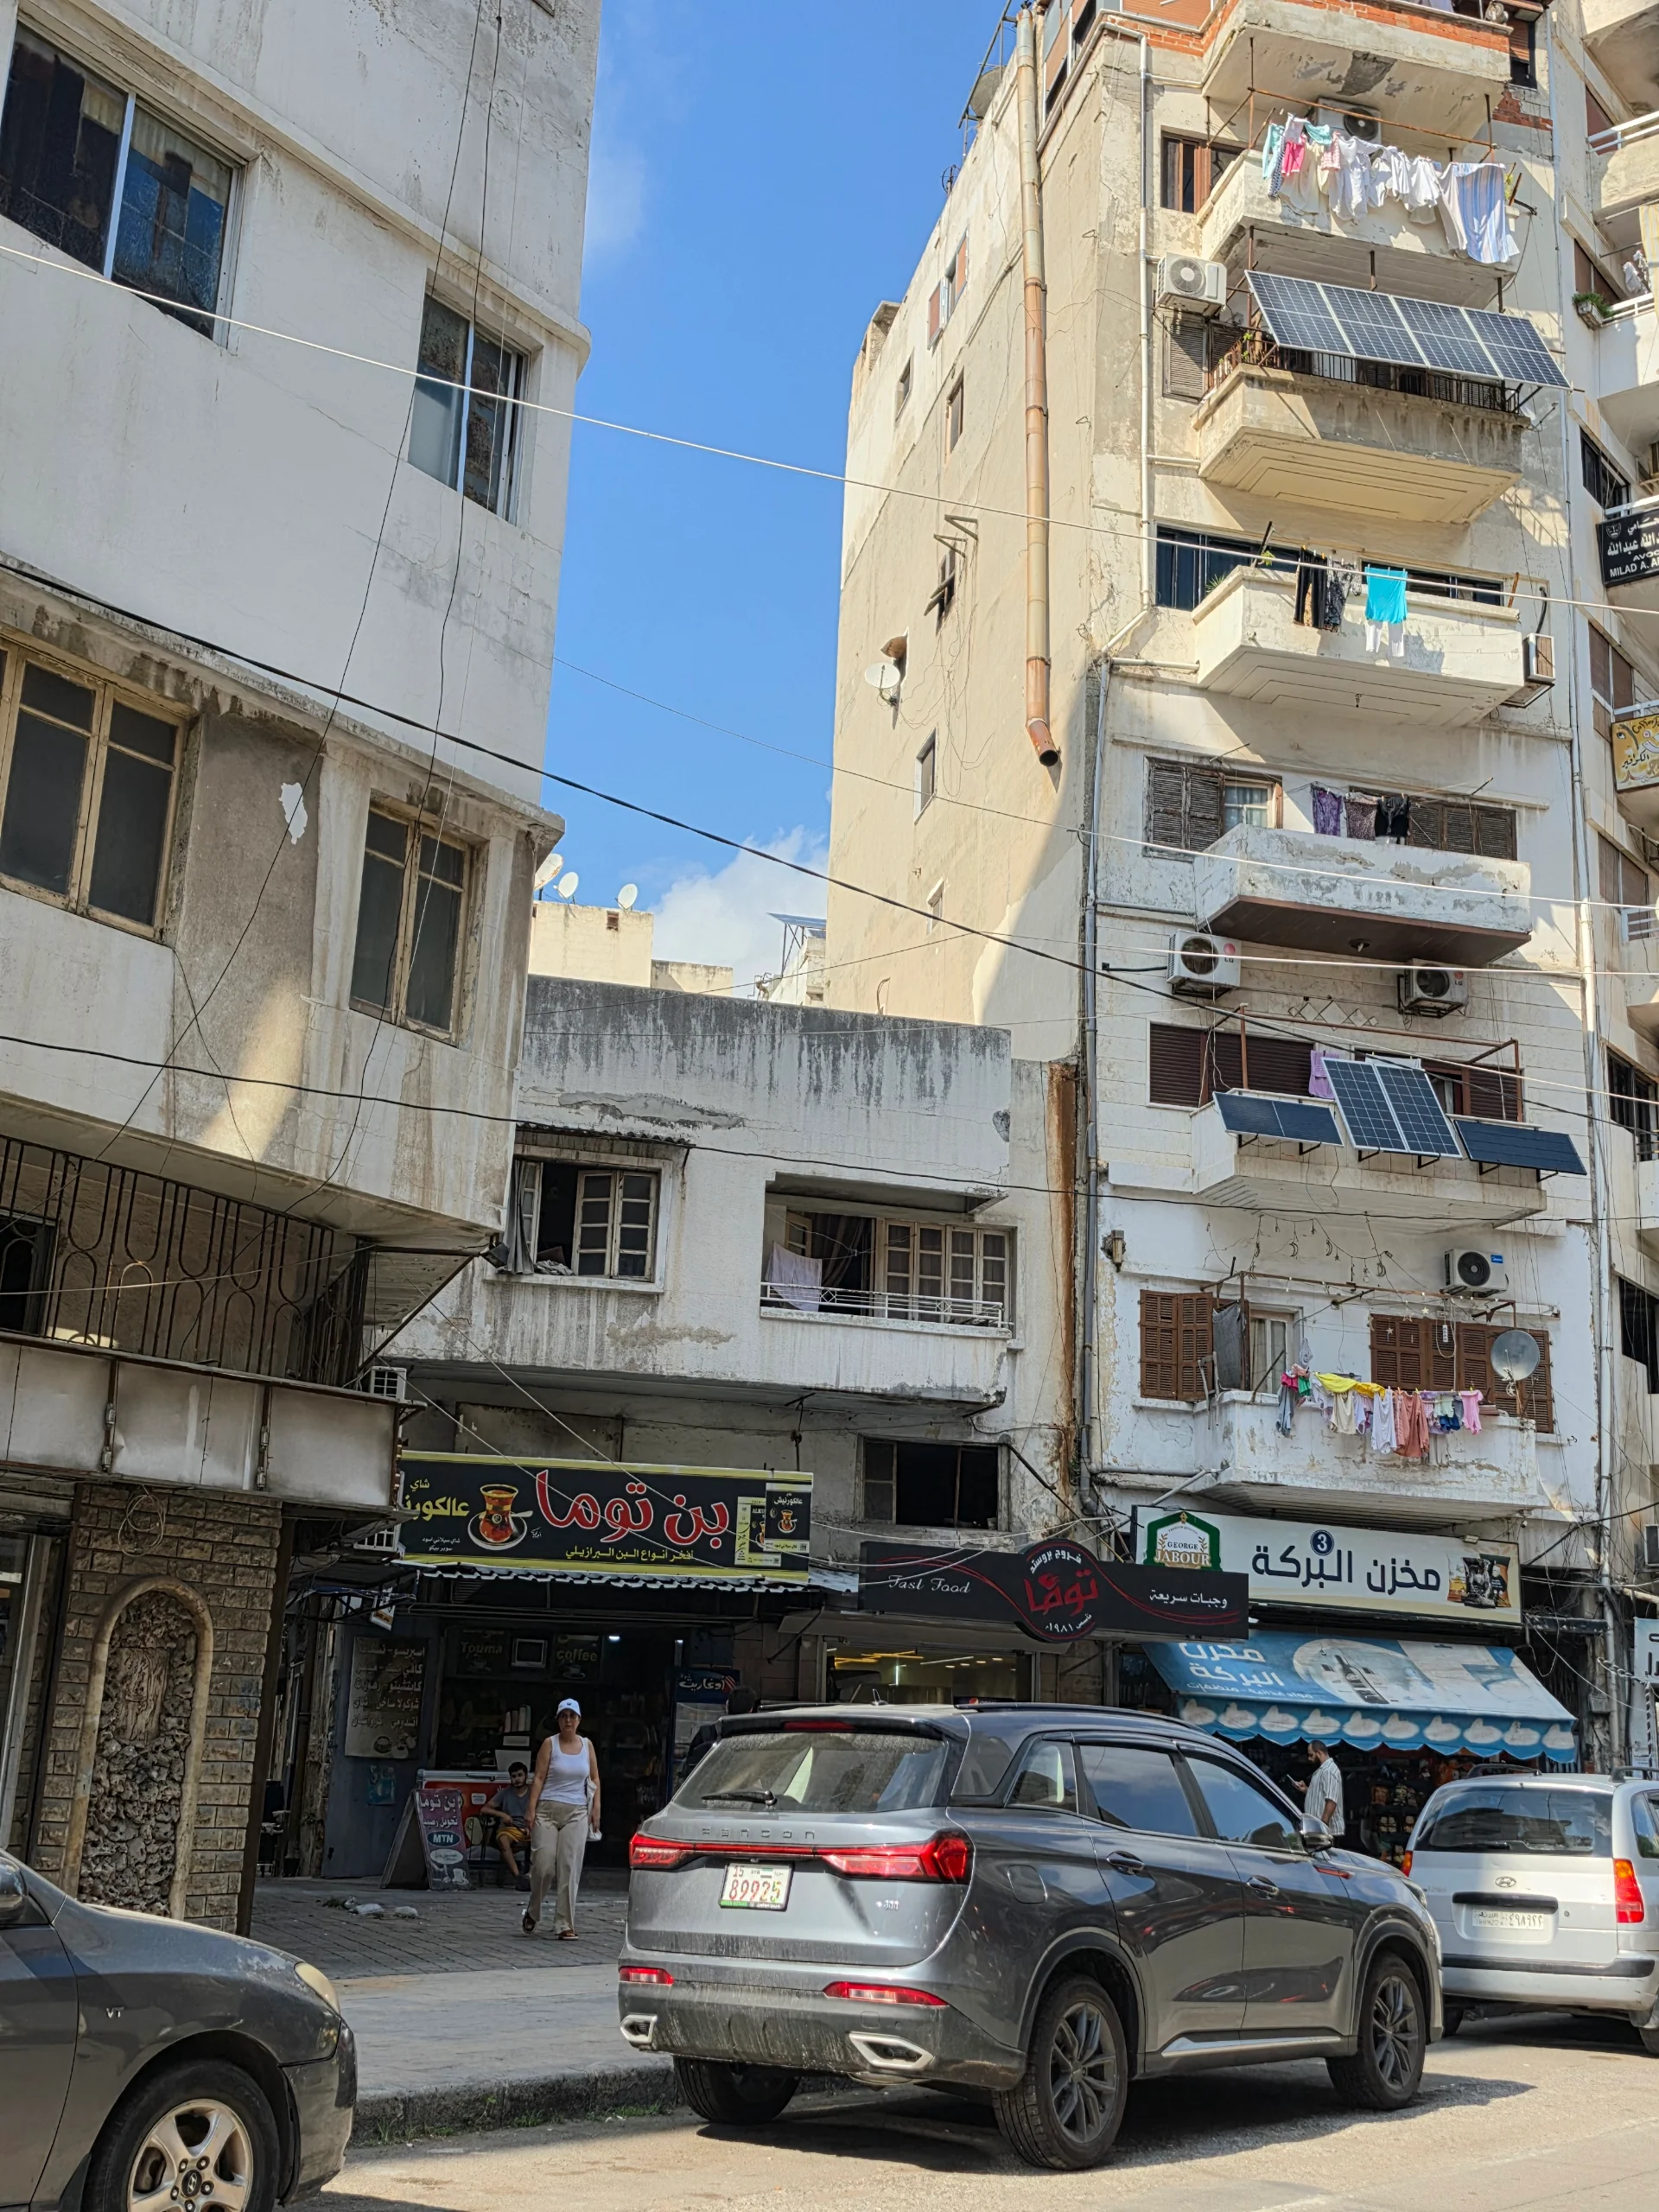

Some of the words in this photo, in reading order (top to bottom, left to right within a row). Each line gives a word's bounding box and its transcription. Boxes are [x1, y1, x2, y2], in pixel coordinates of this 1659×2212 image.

[1610, 563, 1637, 578] MILAD
[1640, 561, 1649, 570] A.
[410, 1478, 430, 1492] شاي
[404, 1494, 470, 1522] عالكورن
[535, 1469, 654, 1543] توما
[664, 1494, 729, 1549] بن
[615, 1548, 639, 1560] البن
[1166, 1541, 1198, 1550] GEORGE
[1154, 1549, 1211, 1567] JABOUR
[1251, 1544, 1353, 1590] البركة
[888, 1574, 925, 1590] Fast
[931, 1578, 971, 1593] Food
[1366, 1556, 1441, 1595] مخزن
[1149, 1587, 1188, 1605] سريعة
[1190, 1592, 1228, 1610] وجبات
[461, 1641, 503, 1655] Touma
[556, 1648, 598, 1662] coffee
[1189, 1662, 1285, 1687] البركة
[420, 1794, 442, 1811] توما
[444, 1796, 456, 1812] بن
[433, 1834, 454, 1843] MTN
[733, 1865, 745, 1878] 15
[728, 1878, 782, 1903] 89925
